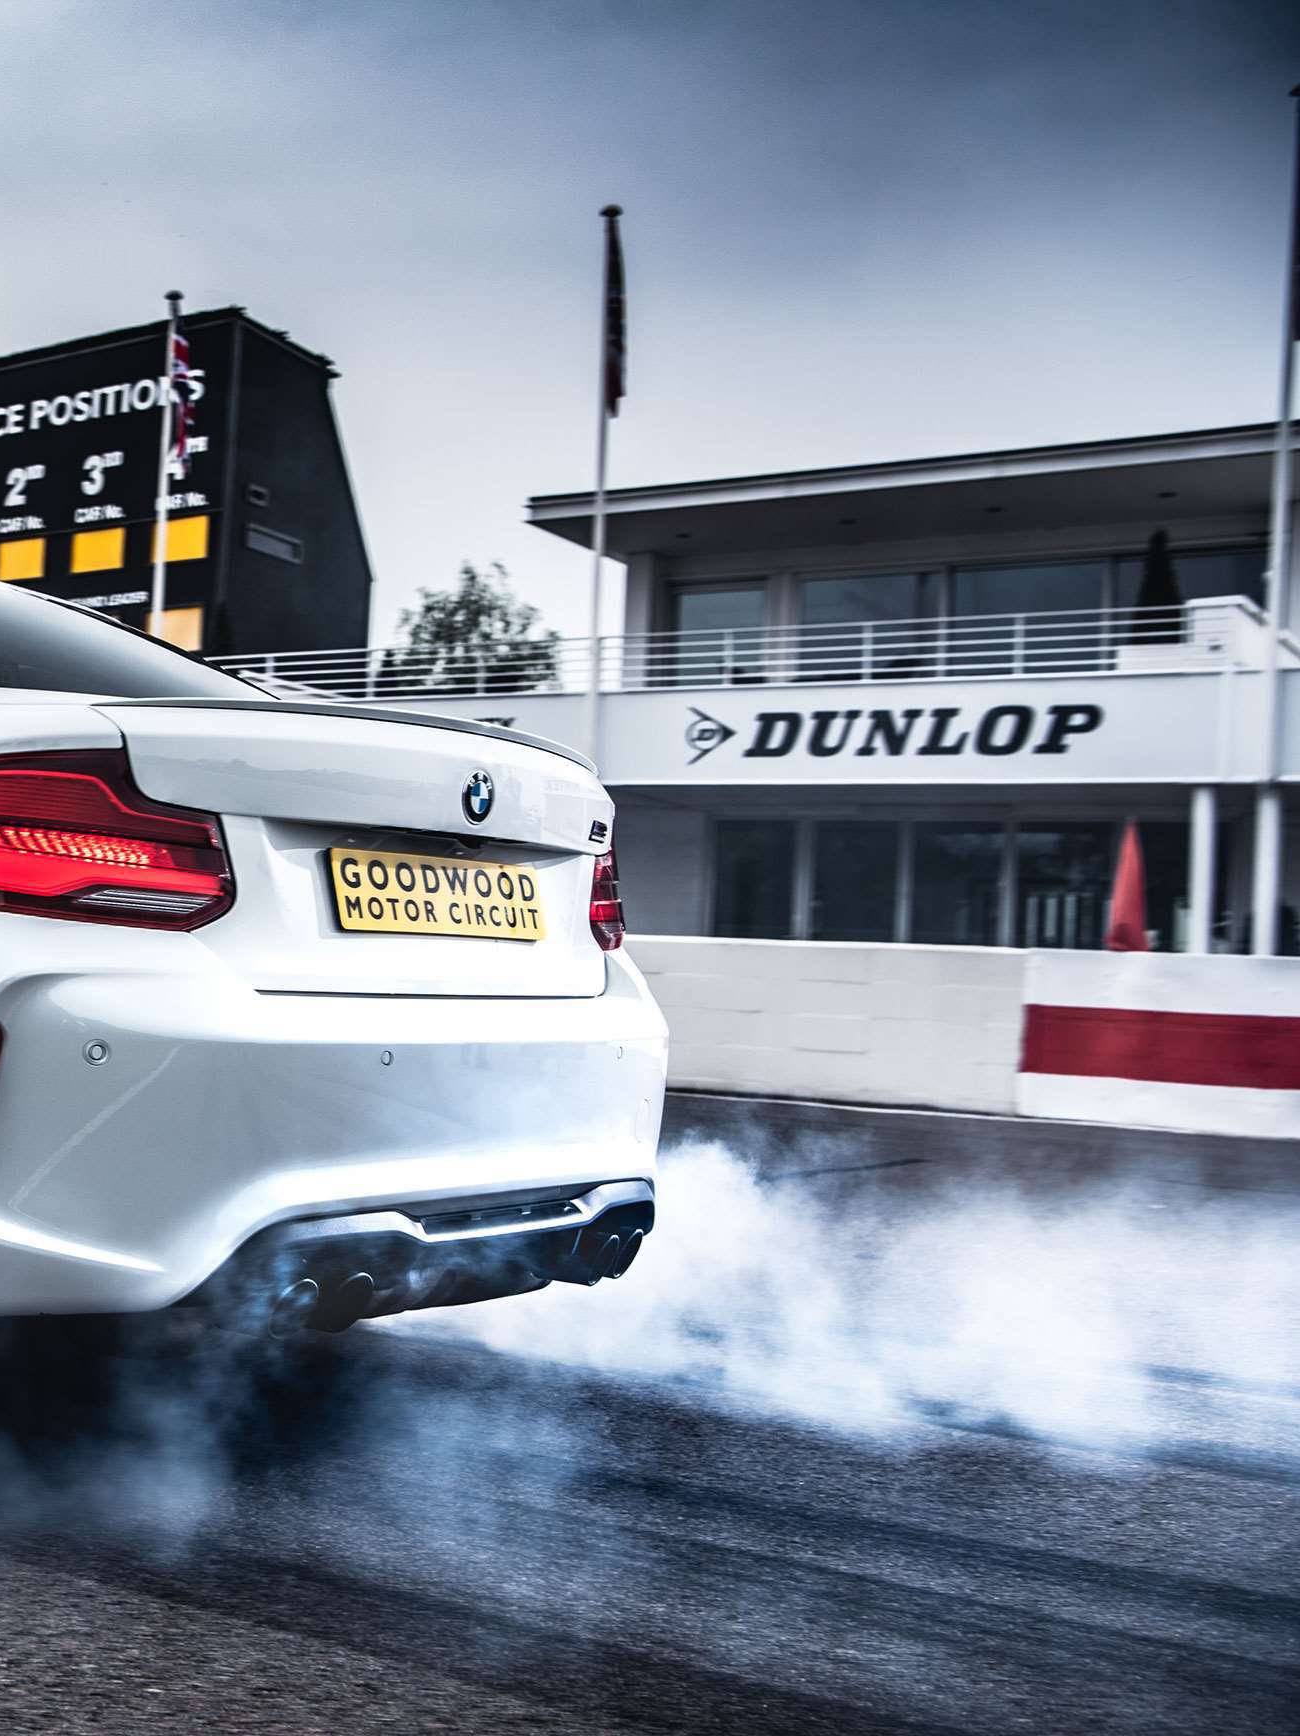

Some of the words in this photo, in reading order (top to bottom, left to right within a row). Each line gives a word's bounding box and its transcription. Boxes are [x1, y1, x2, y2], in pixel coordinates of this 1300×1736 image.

[28, 369, 205, 429] POSITIONS
[742, 703, 1105, 760] DUNLOP
[339, 857, 535, 902] GOODWOOD
[344, 895, 438, 923] MOTOR
[448, 902, 539, 929] CIRCUIT
